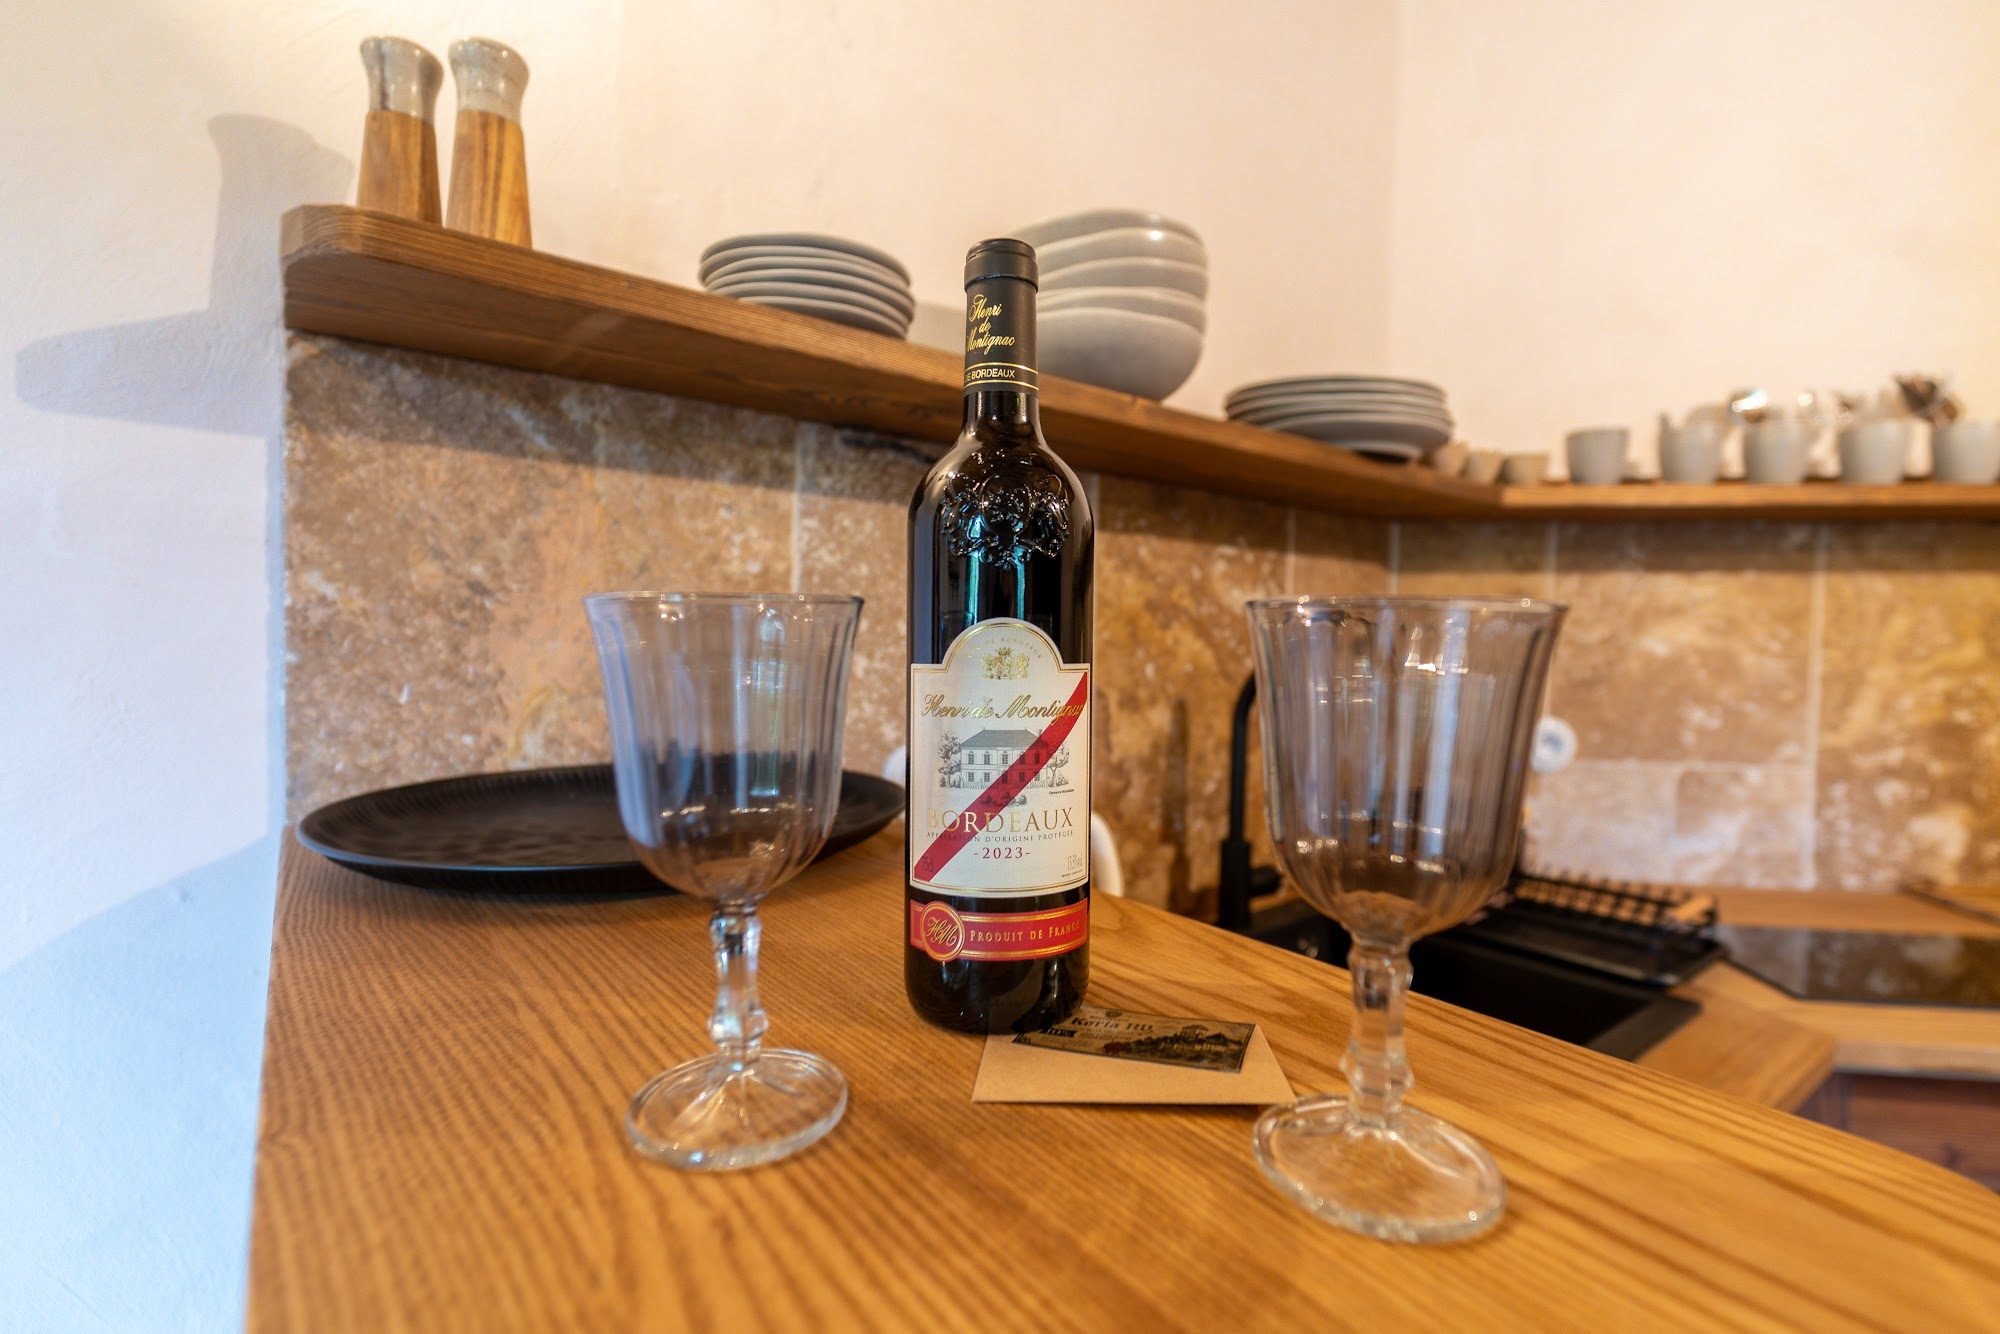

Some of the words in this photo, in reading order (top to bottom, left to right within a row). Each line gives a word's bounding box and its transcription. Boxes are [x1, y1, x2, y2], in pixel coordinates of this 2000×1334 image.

[969, 294, 1002, 322] Henri
[979, 317, 992, 333] de
[972, 368, 1016, 379] BORDEAUX
[921, 694, 971, 718] Henri
[970, 698, 995, 718] de
[928, 807, 1073, 833] BORDEAUX
[985, 835, 1034, 843] D'ORIGINE
[970, 929, 1024, 943] PRODUIT
[1030, 930, 1042, 940] DE
